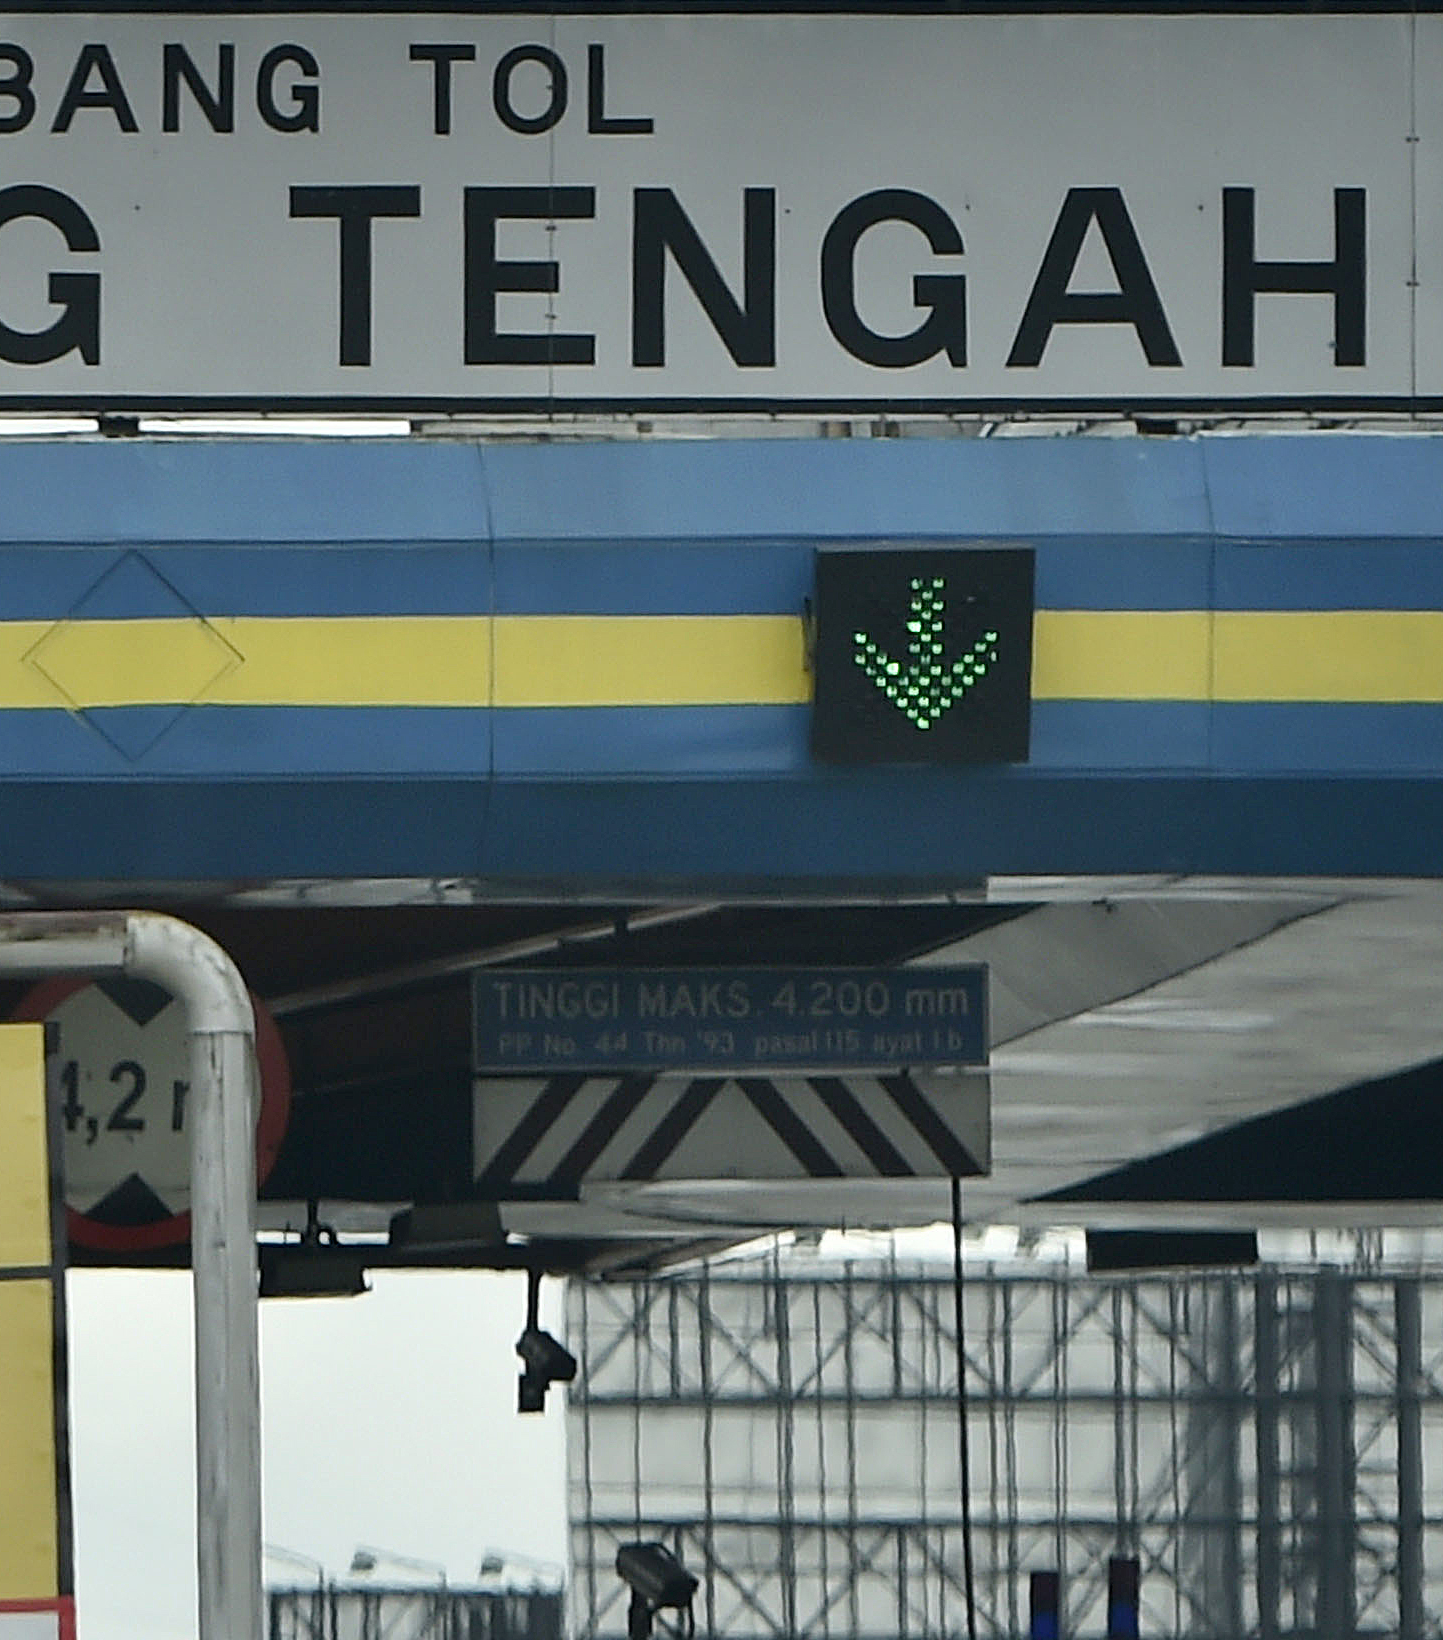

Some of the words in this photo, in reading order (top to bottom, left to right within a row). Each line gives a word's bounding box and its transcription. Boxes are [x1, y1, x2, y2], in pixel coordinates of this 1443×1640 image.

[408, 43, 654, 136] TOL
[288, 184, 1367, 369] TENGAH
[493, 982, 620, 1020] TINGGI
[639, 980, 763, 1019] MAKS.
[771, 979, 891, 1017] 4.200
[903, 985, 971, 1017] mm
